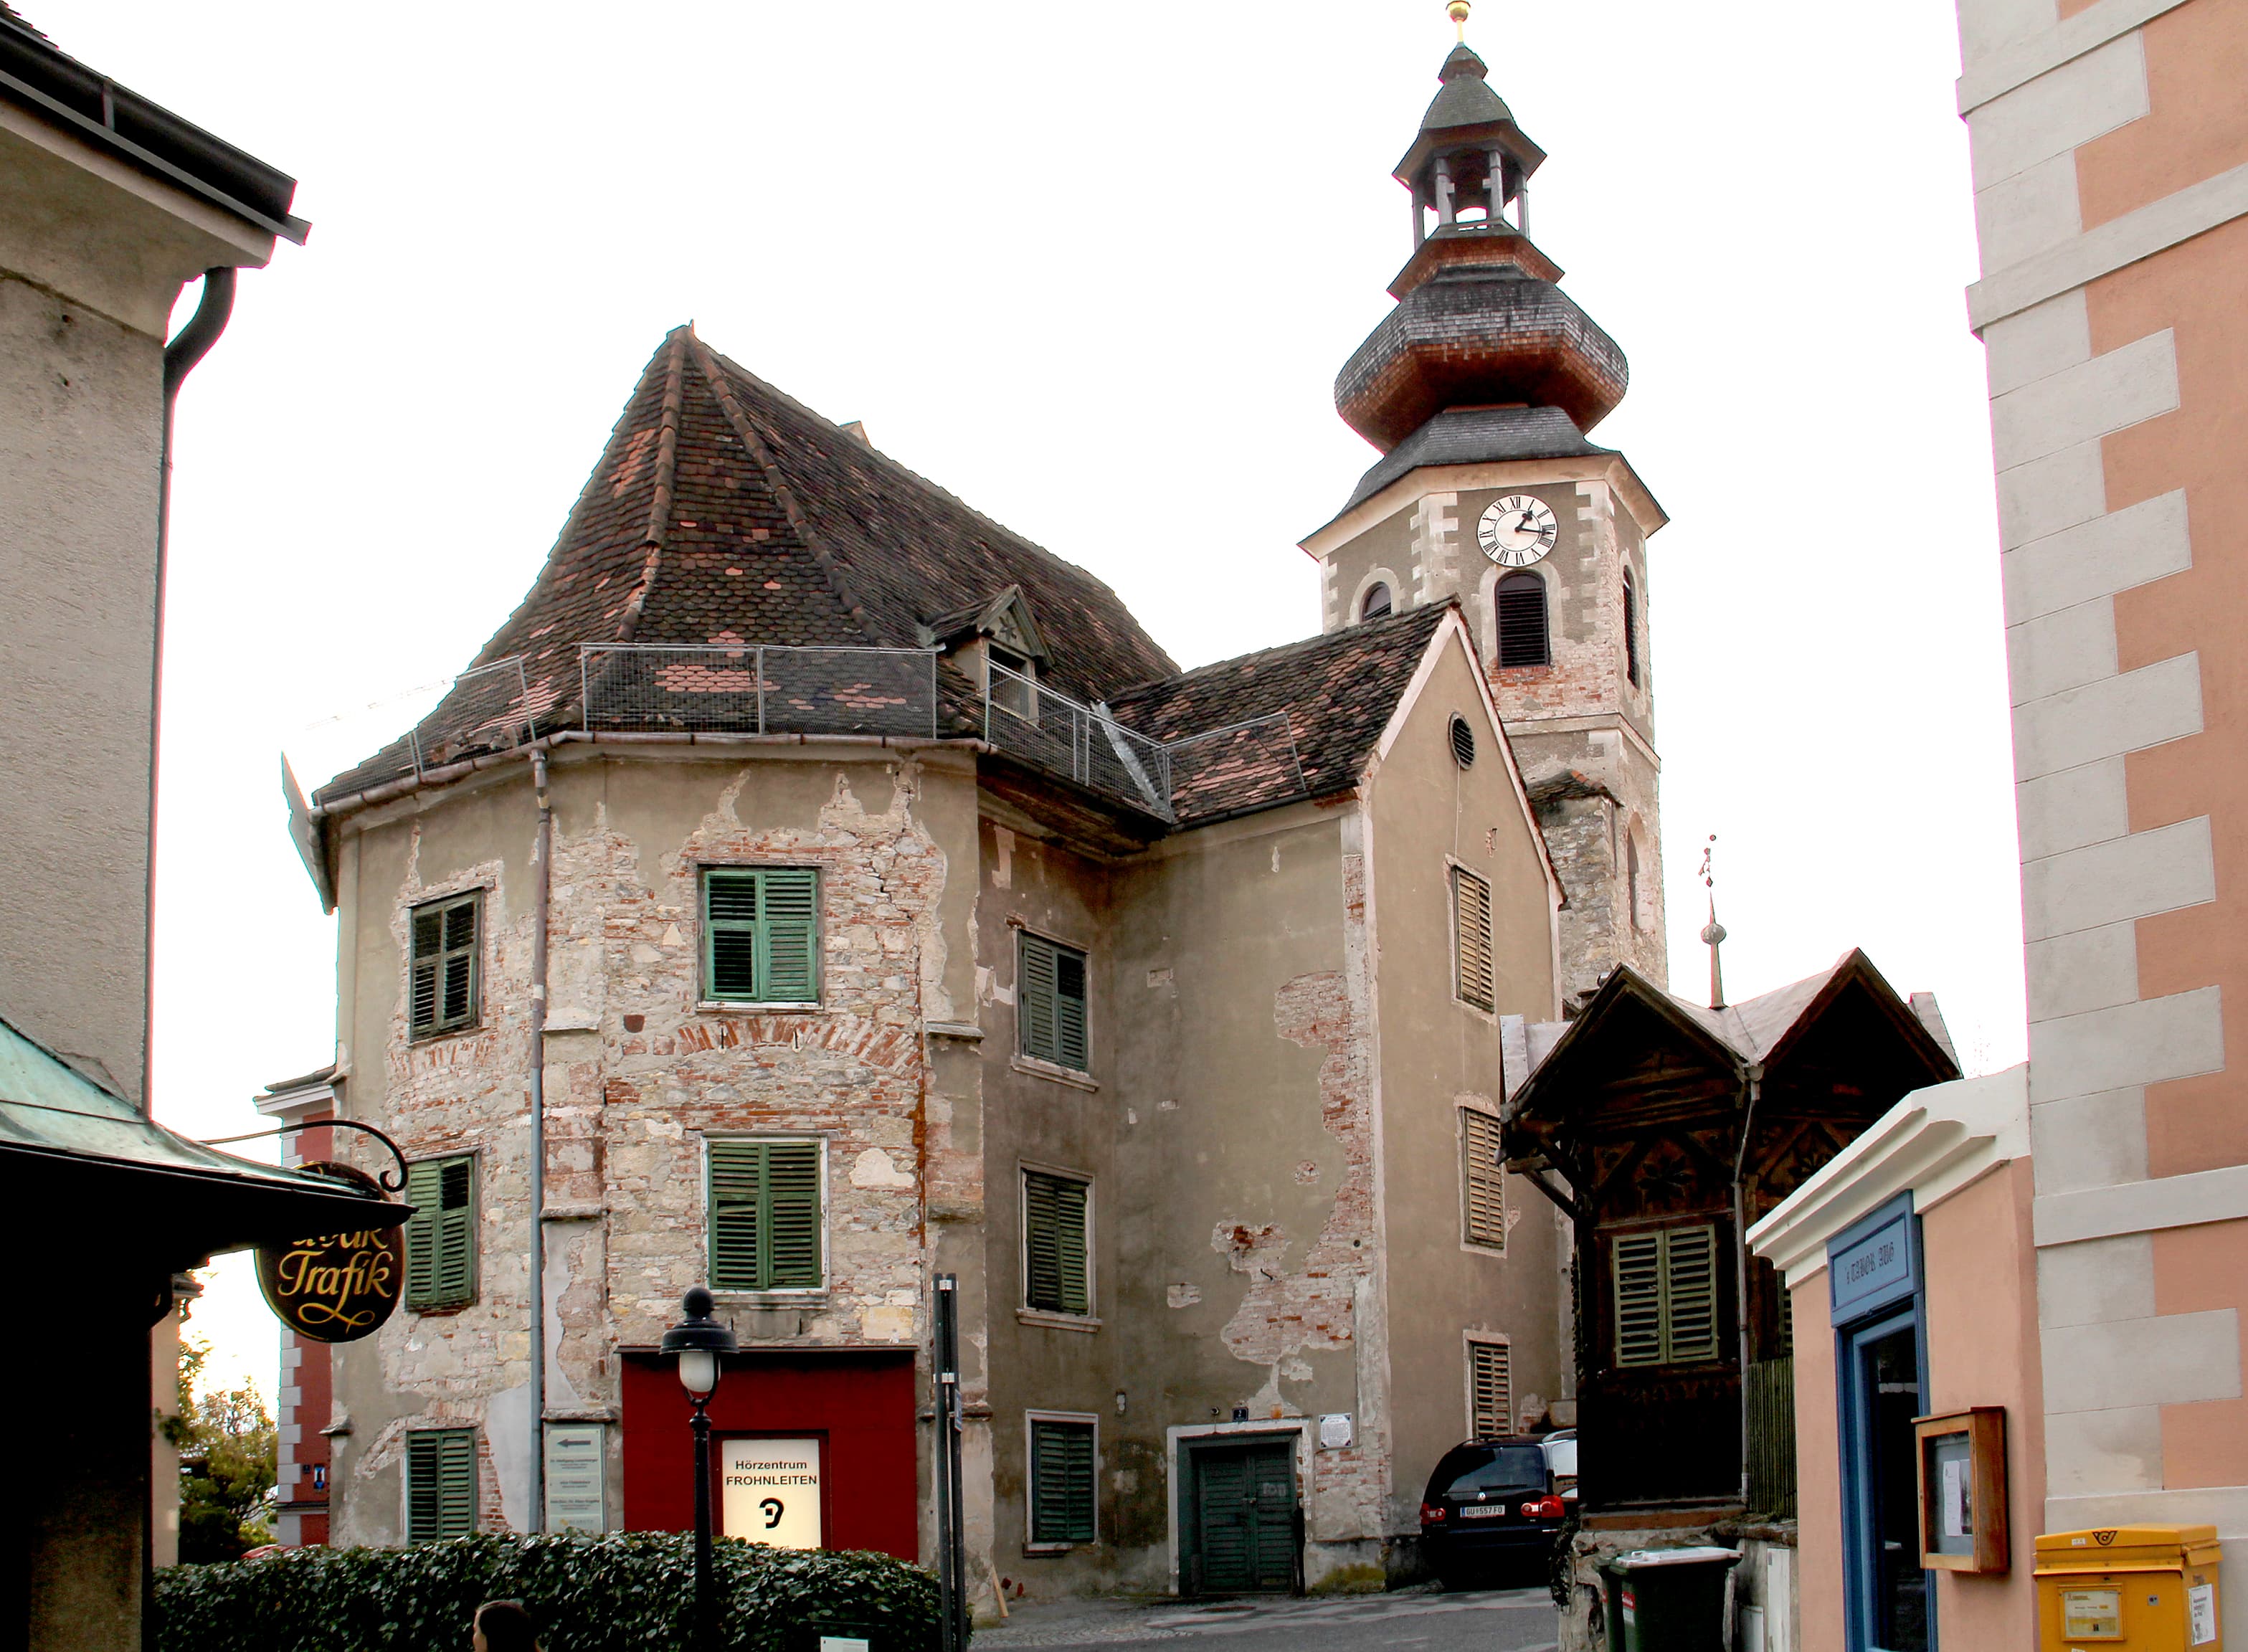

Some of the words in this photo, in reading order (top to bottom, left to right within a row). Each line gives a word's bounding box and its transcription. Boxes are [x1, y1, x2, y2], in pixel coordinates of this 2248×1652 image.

[1493, 501, 1507, 516] XI
[1509, 496, 1521, 510] XII
[1527, 499, 1535, 511] I
[1482, 514, 1497, 524] X
[1537, 508, 1550, 519] II
[1479, 529, 1493, 538] IX
[1497, 549, 1509, 564] VII
[1515, 552, 1525, 565] VI
[1531, 548, 1542, 560] V
[277, 1250, 394, 1324] Trafik
[736, 1461, 807, 1469] Hörzentrum
[726, 1476, 817, 1485] FROHNLEITEN
